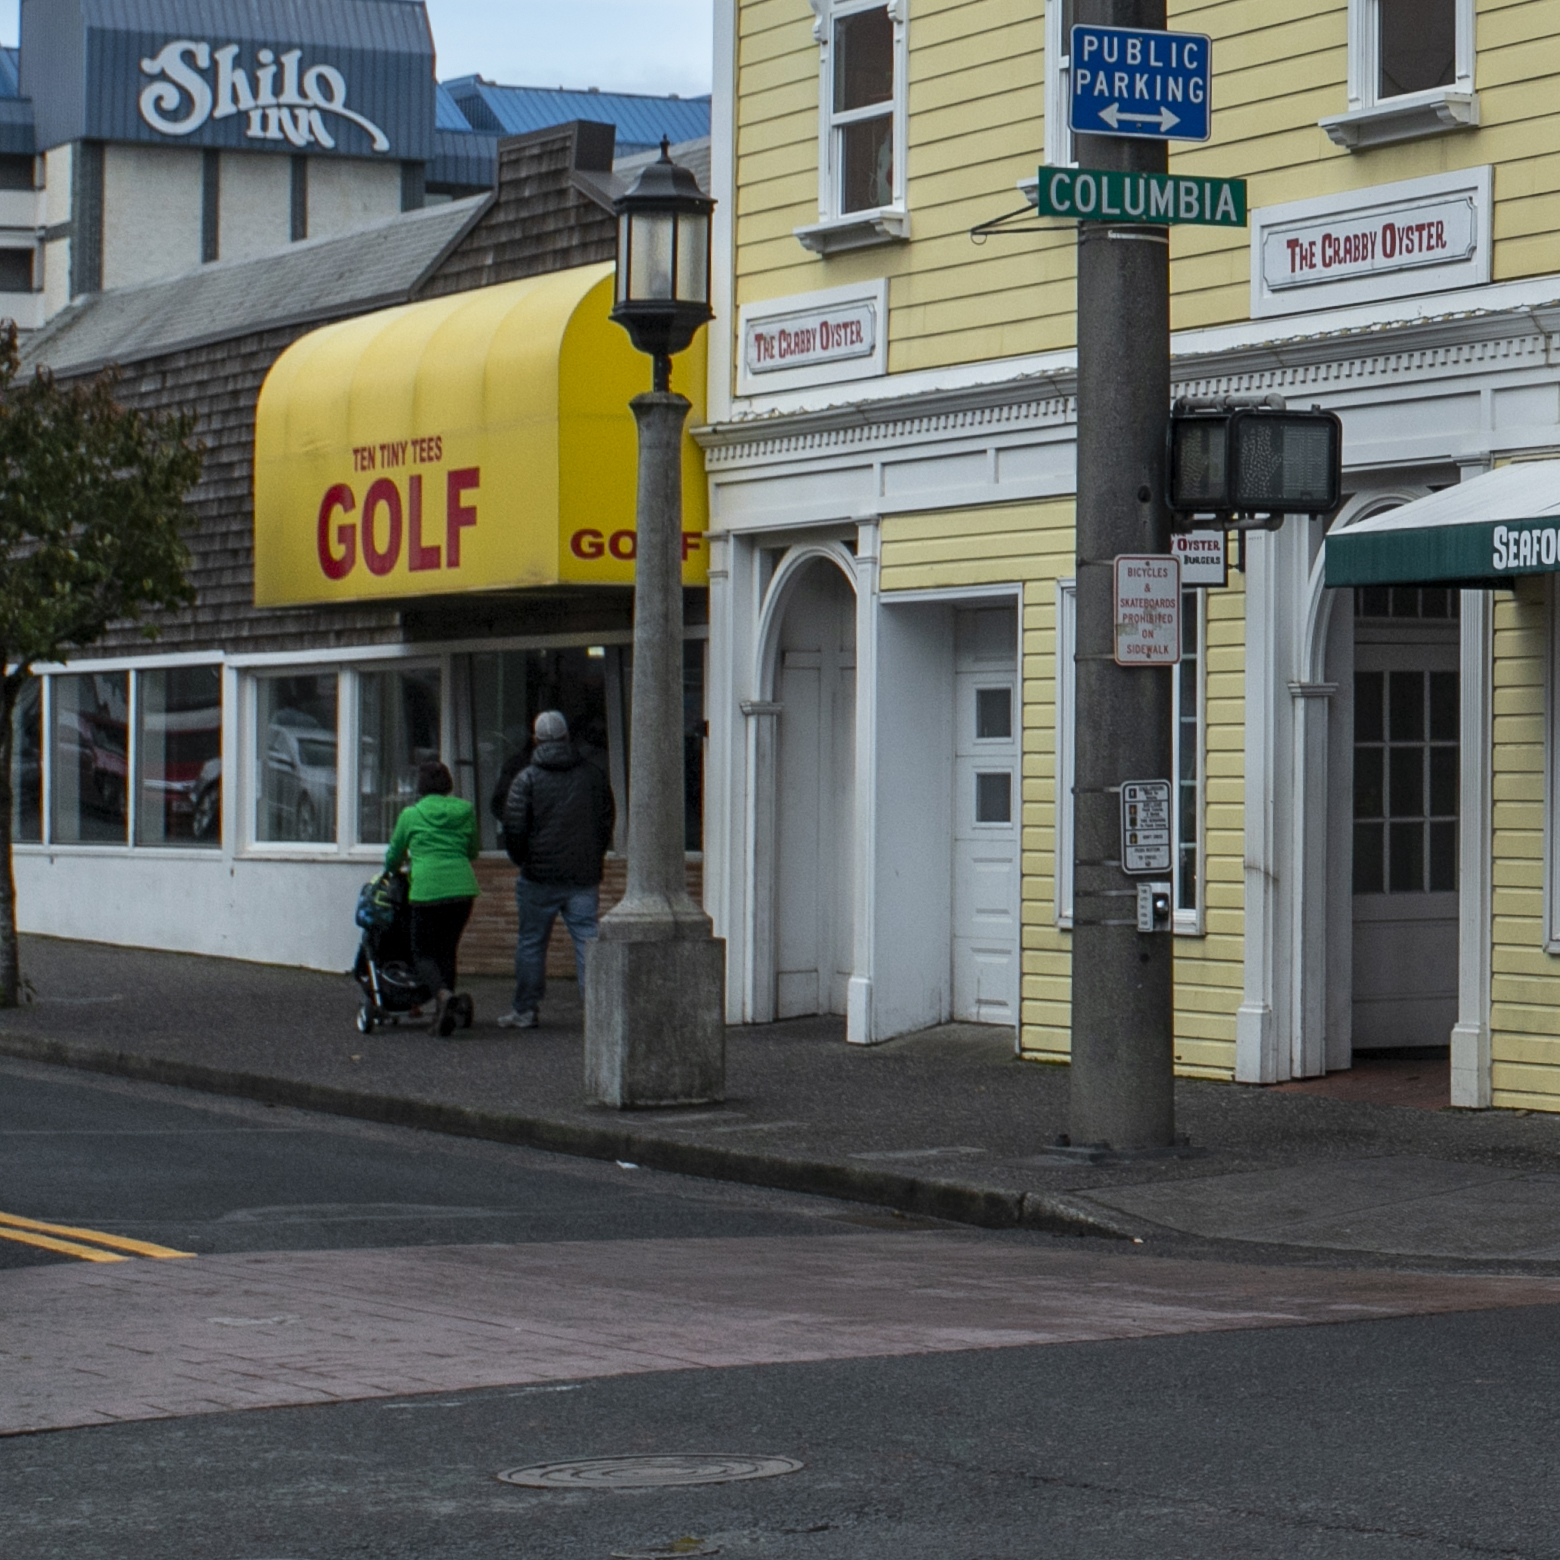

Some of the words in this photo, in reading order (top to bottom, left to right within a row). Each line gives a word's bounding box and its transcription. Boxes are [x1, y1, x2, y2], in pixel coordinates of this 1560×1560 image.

[1083, 35, 1199, 70] PUBLIC
[139, 40, 390, 151] Shilo
[1076, 70, 1204, 103] PARKING
[1049, 173, 1238, 222] COLUMBIA
[353, 445, 376, 472] TEN
[380, 440, 408, 469] TINY
[411, 435, 443, 464] TEES
[317, 466, 480, 581] GOLF
[570, 528, 703, 561] GOF
[1127, 567, 1168, 578] BICYCLES
[1144, 583, 1151, 593] &
[1120, 598, 1176, 608] SKATEBOARDS
[1122, 613, 1173, 624] PROHIBITED
[1127, 644, 1169, 655] SIDEWALK
[1142, 629, 1154, 639] ON
